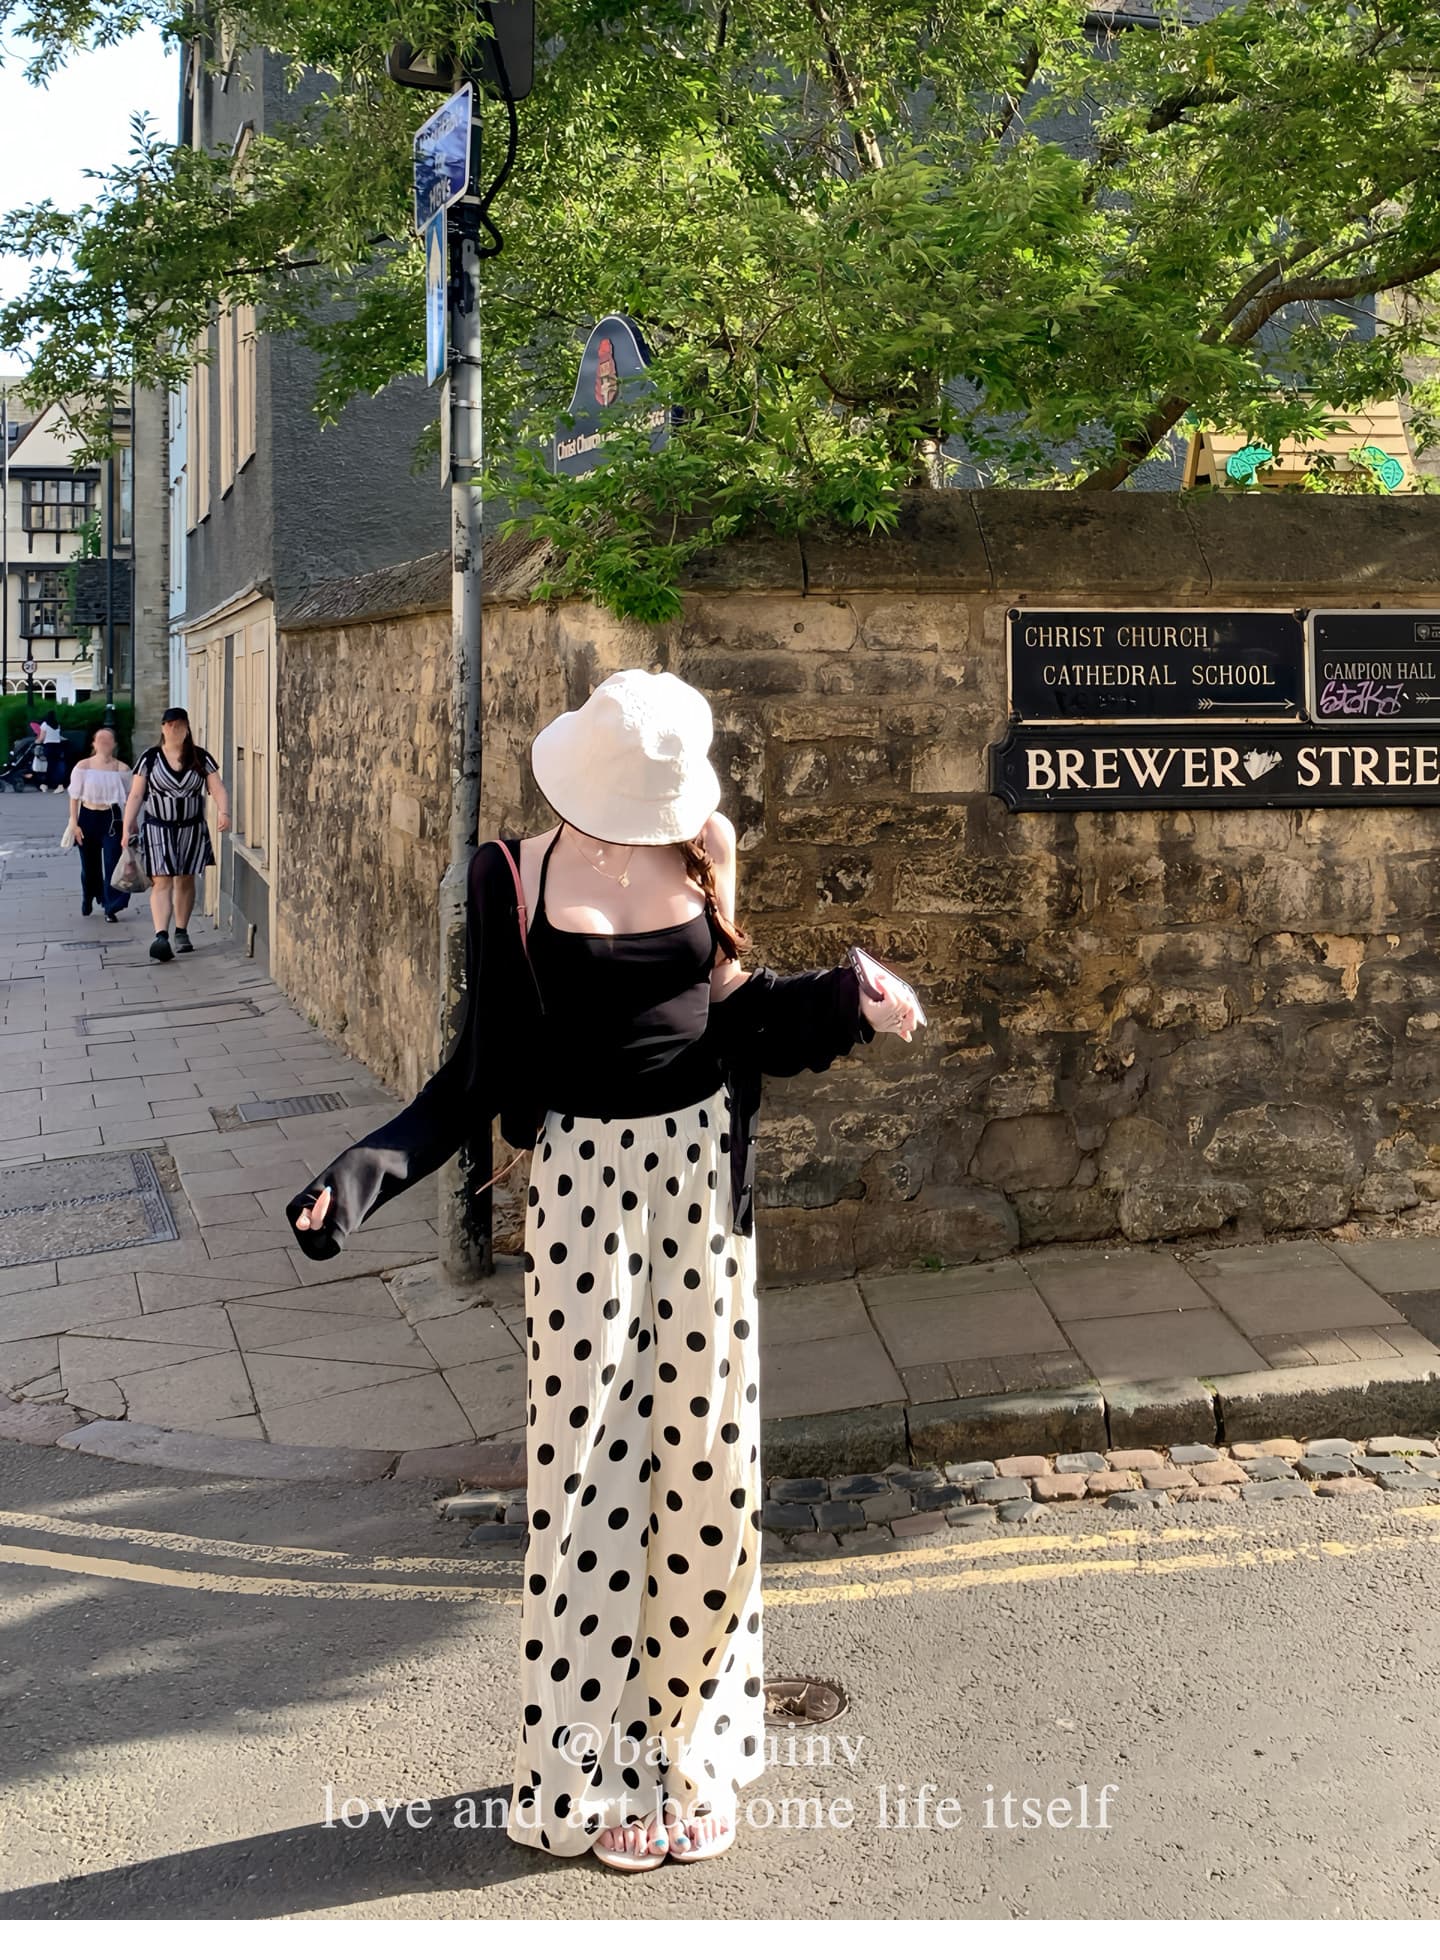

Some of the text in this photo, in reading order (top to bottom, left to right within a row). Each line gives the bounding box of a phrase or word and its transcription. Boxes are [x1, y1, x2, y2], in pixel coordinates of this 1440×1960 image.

[1025, 626, 1208, 648] CHRIST CHURCH
[1043, 665, 1276, 686] CATHEDRAL SCHOOL
[1323, 662, 1436, 681] CAMPION HALL
[1025, 747, 1246, 790] BREWER
